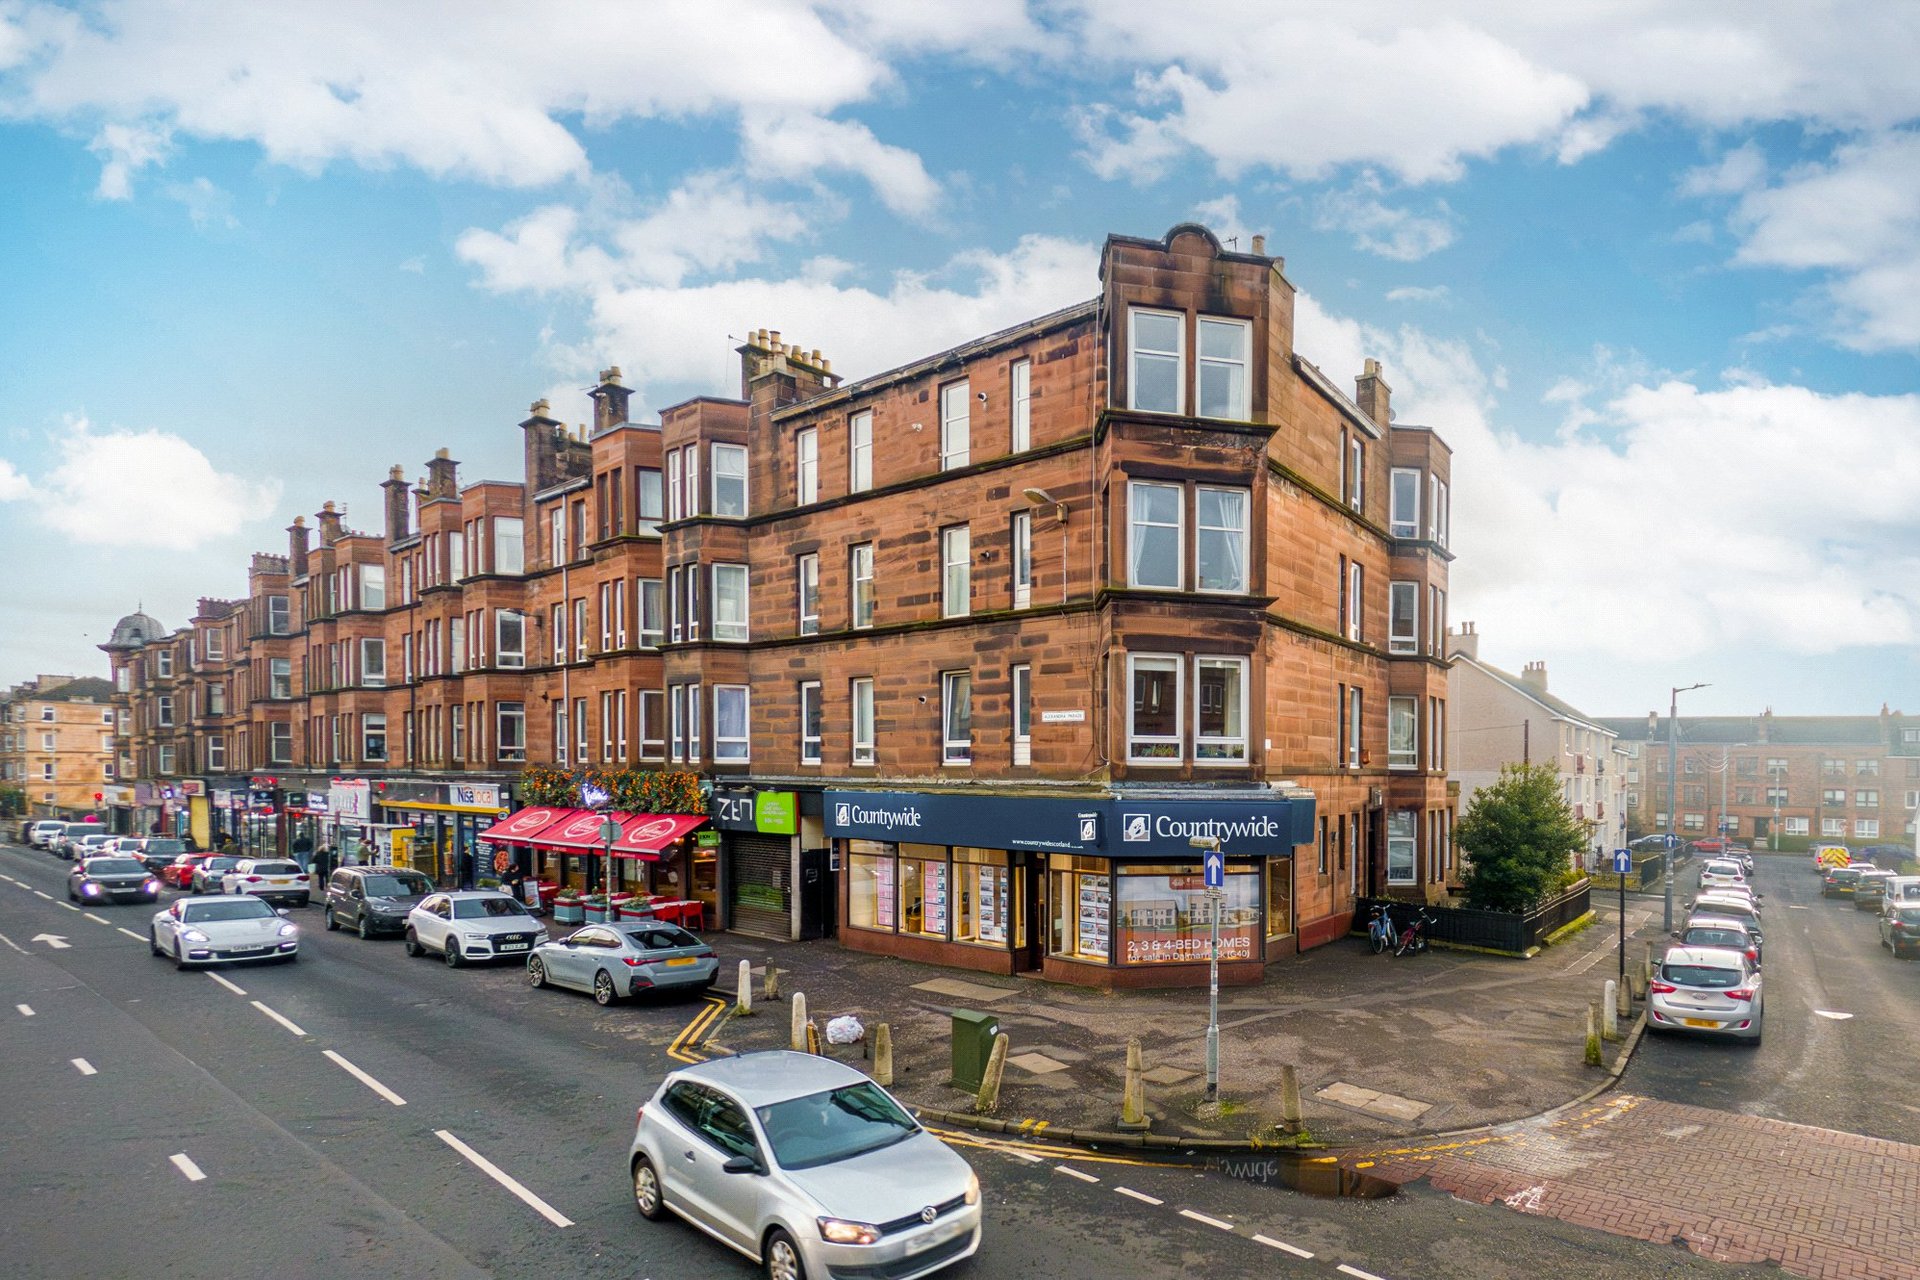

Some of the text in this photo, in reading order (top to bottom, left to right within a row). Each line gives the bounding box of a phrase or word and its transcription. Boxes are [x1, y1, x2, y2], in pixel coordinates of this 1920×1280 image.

[457, 786, 474, 804] Nisa
[851, 805, 921, 830] Countrywide
[1156, 815, 1278, 843] Countrywide
[1127, 936, 1250, 953] 2, 3 & 4-BED HOMES
[1127, 949, 1250, 962] for sale in Dalmarnck (G40)
